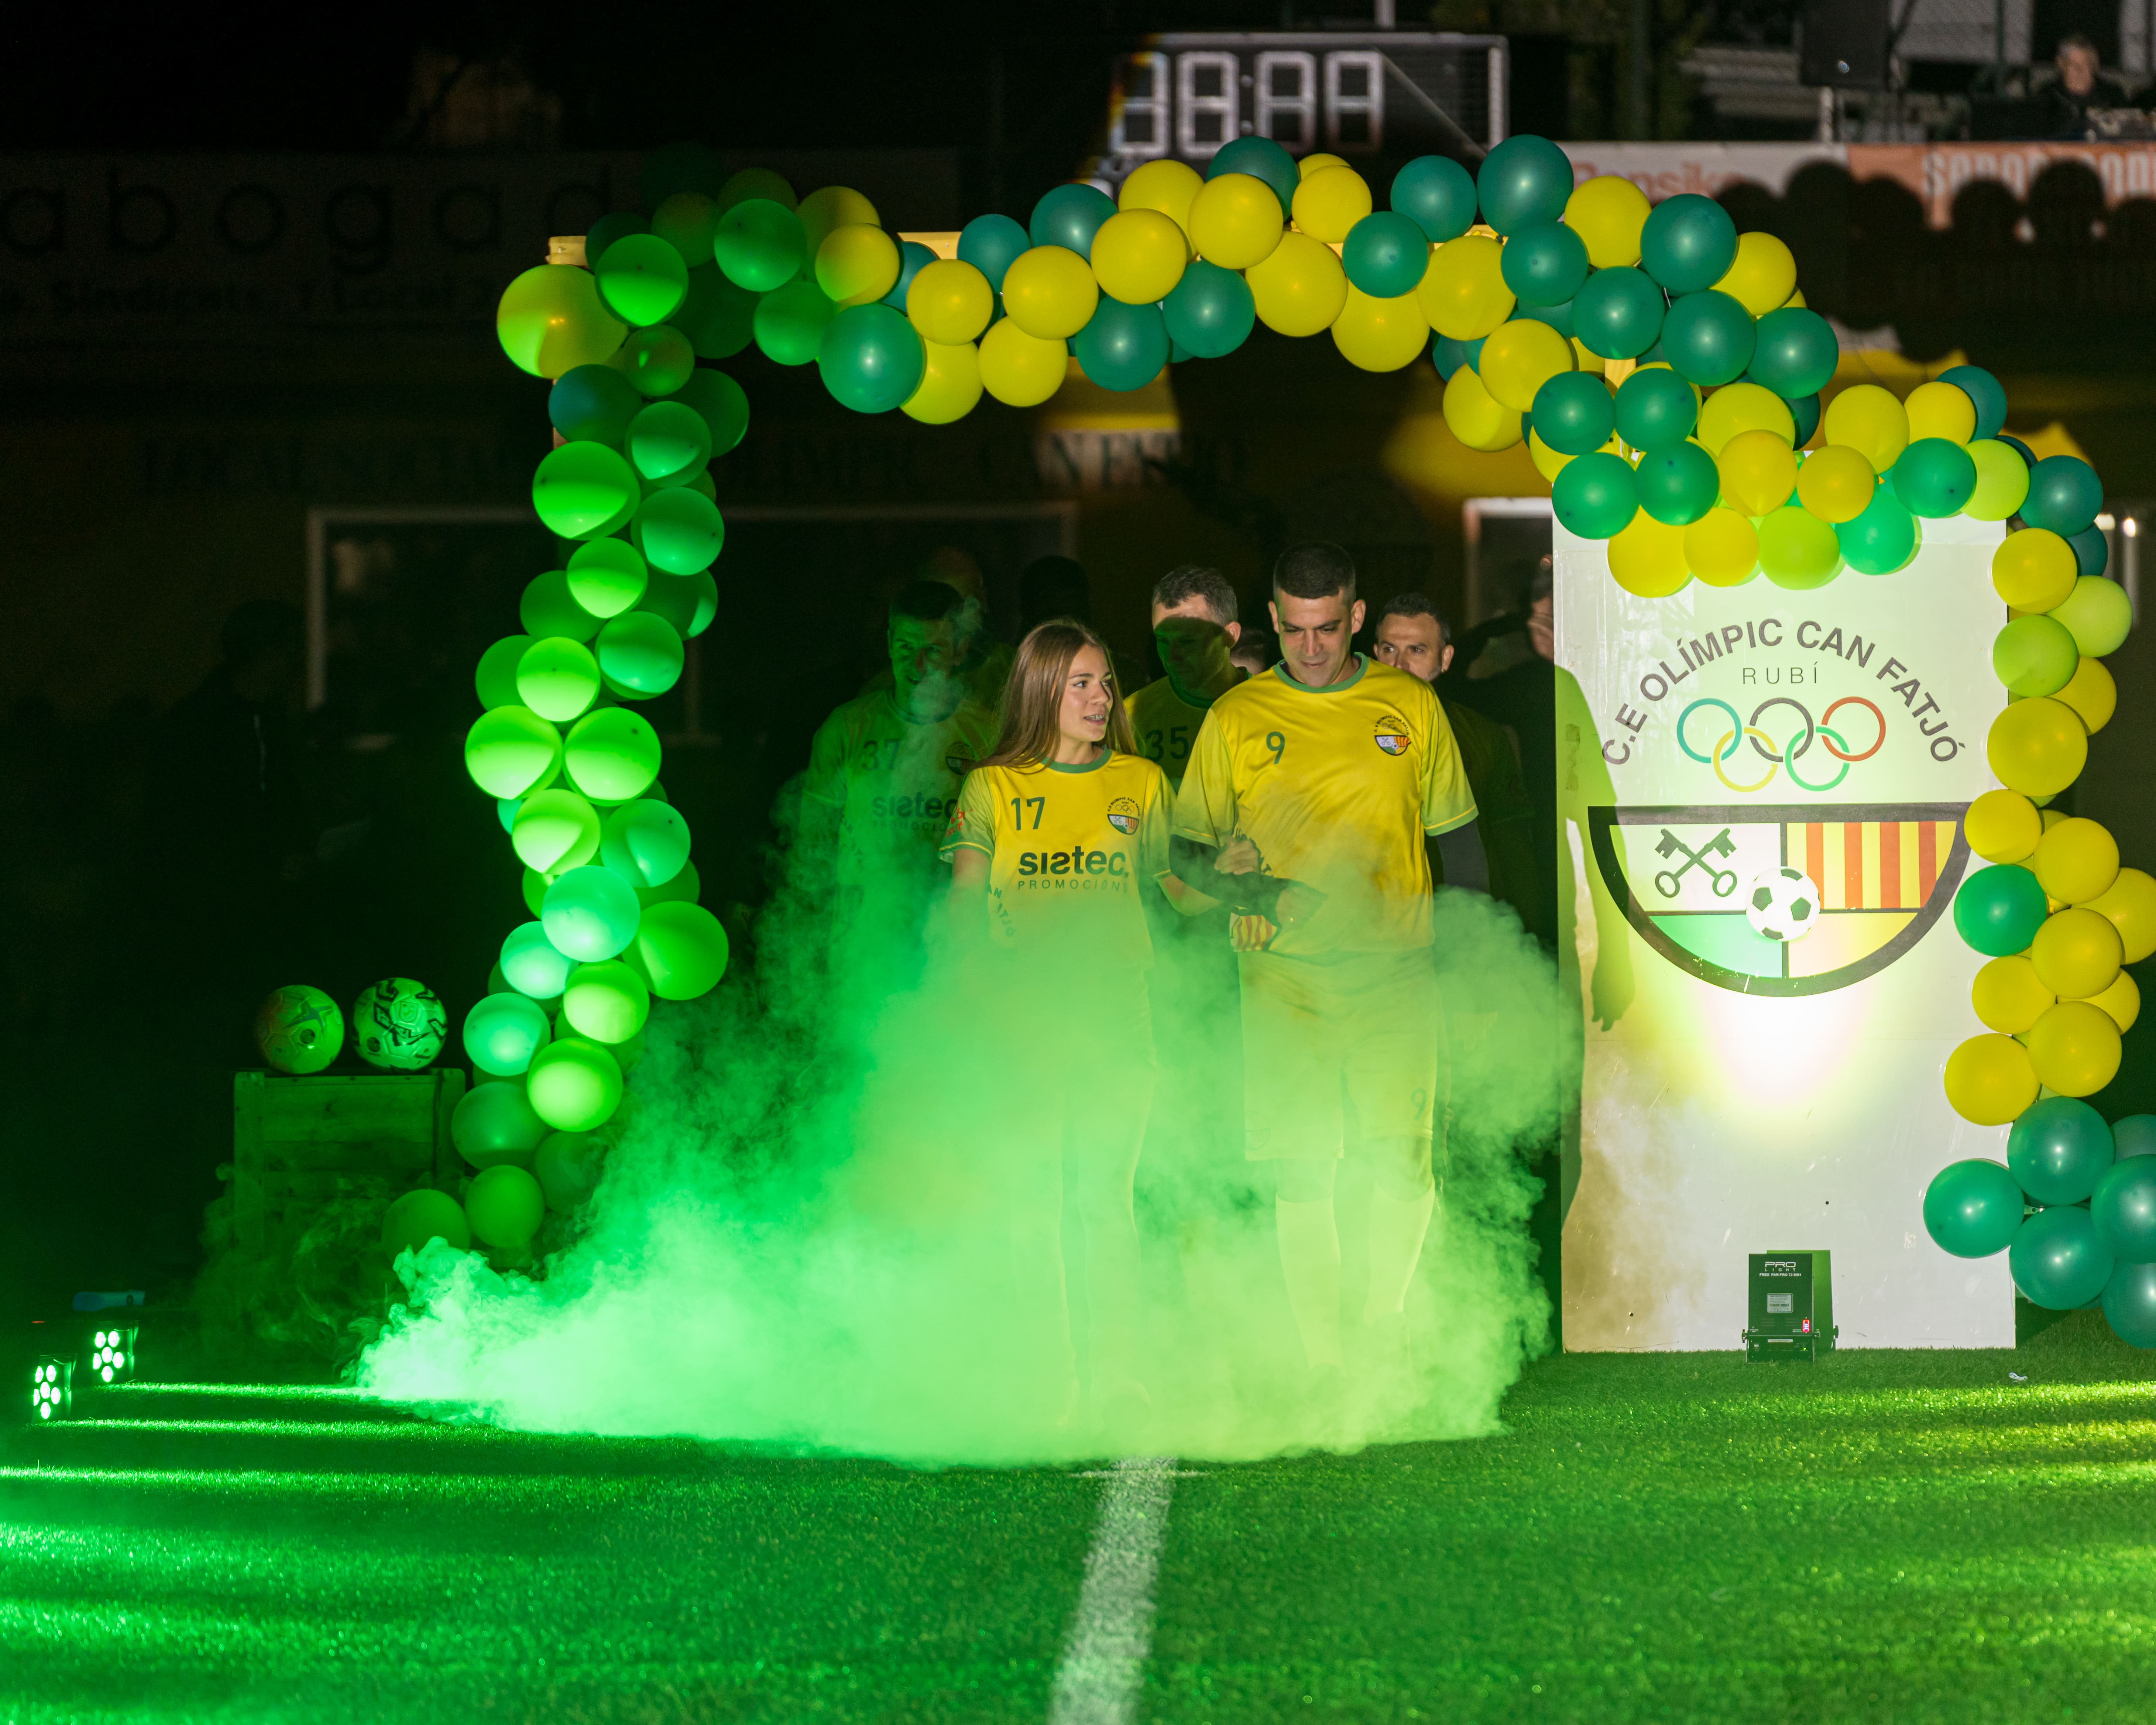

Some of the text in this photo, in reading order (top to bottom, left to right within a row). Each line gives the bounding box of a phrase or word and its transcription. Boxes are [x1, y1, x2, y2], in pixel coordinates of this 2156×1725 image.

[1743, 661, 1818, 684] RUBÍ
[1602, 618, 1966, 765] C.E OLÍMPIC CAN FATJÓ
[1146, 726, 1189, 762] 35
[1266, 731, 1285, 765] 9
[1011, 796, 1045, 831] 17
[1410, 1087, 1427, 1121] 9
